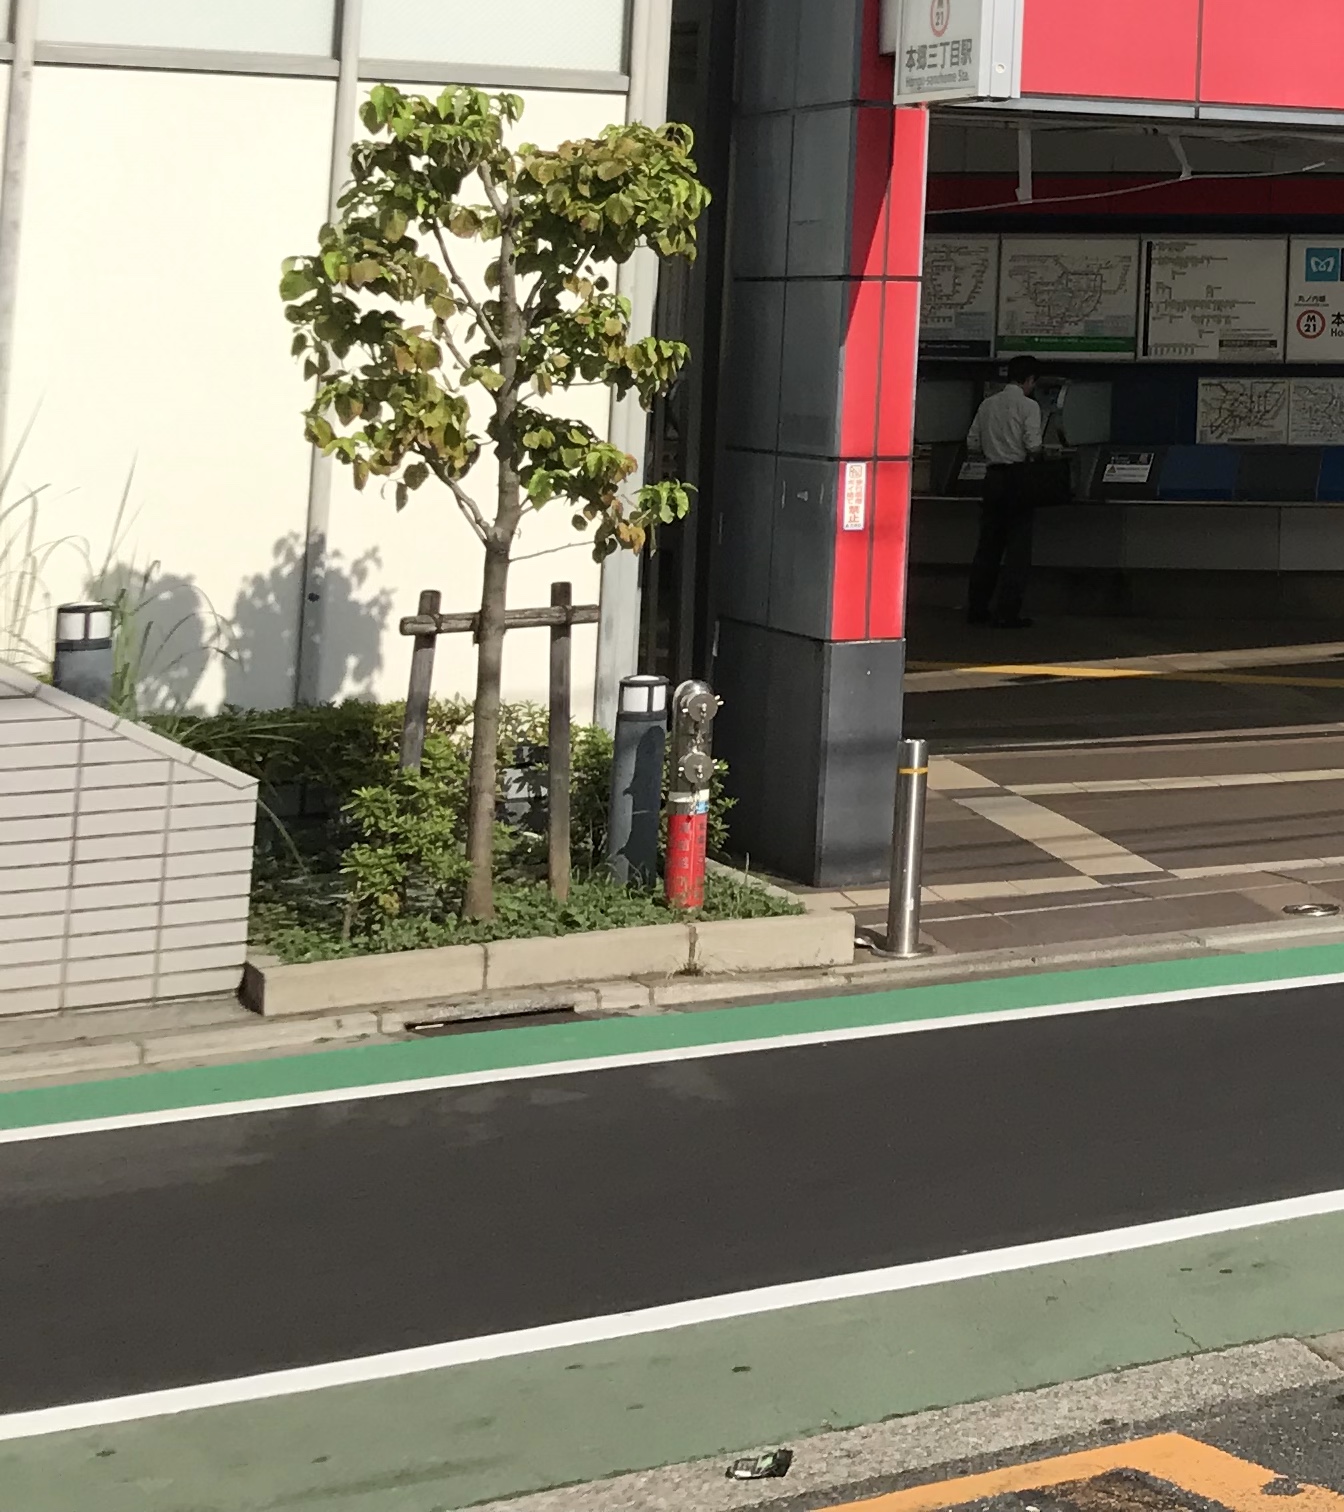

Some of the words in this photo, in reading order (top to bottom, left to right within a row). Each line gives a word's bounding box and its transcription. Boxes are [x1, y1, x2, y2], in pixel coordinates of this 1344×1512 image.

[905, 38, 972, 72] 本郷三丁目駅
[1306, 315, 1316, 323] M
[1304, 324, 1316, 333] 21
